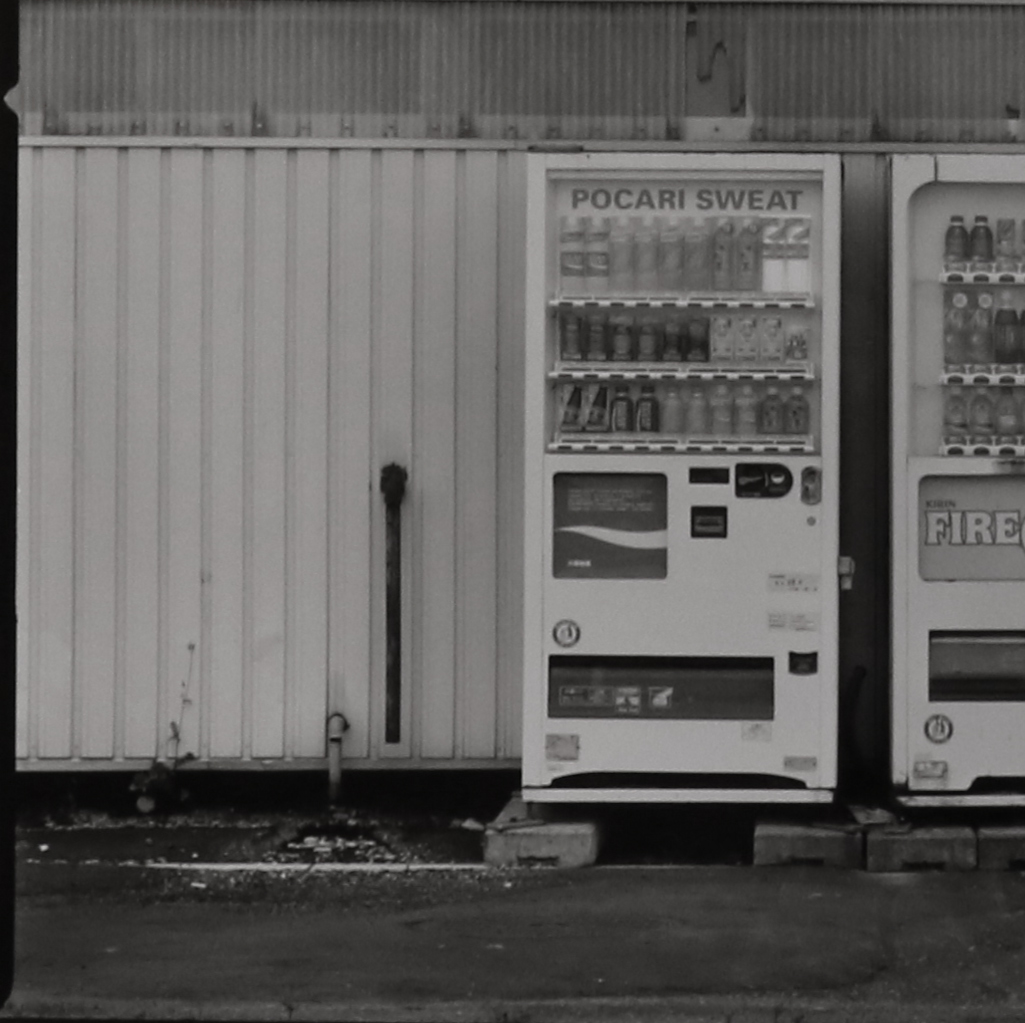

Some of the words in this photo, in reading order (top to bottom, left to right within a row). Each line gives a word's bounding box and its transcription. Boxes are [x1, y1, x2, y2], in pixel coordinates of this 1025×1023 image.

[571, 188, 685, 210] POCARI
[696, 189, 804, 211] SWEAT
[925, 499, 957, 508] KIRIN
[924, 510, 1022, 546] FIRE
